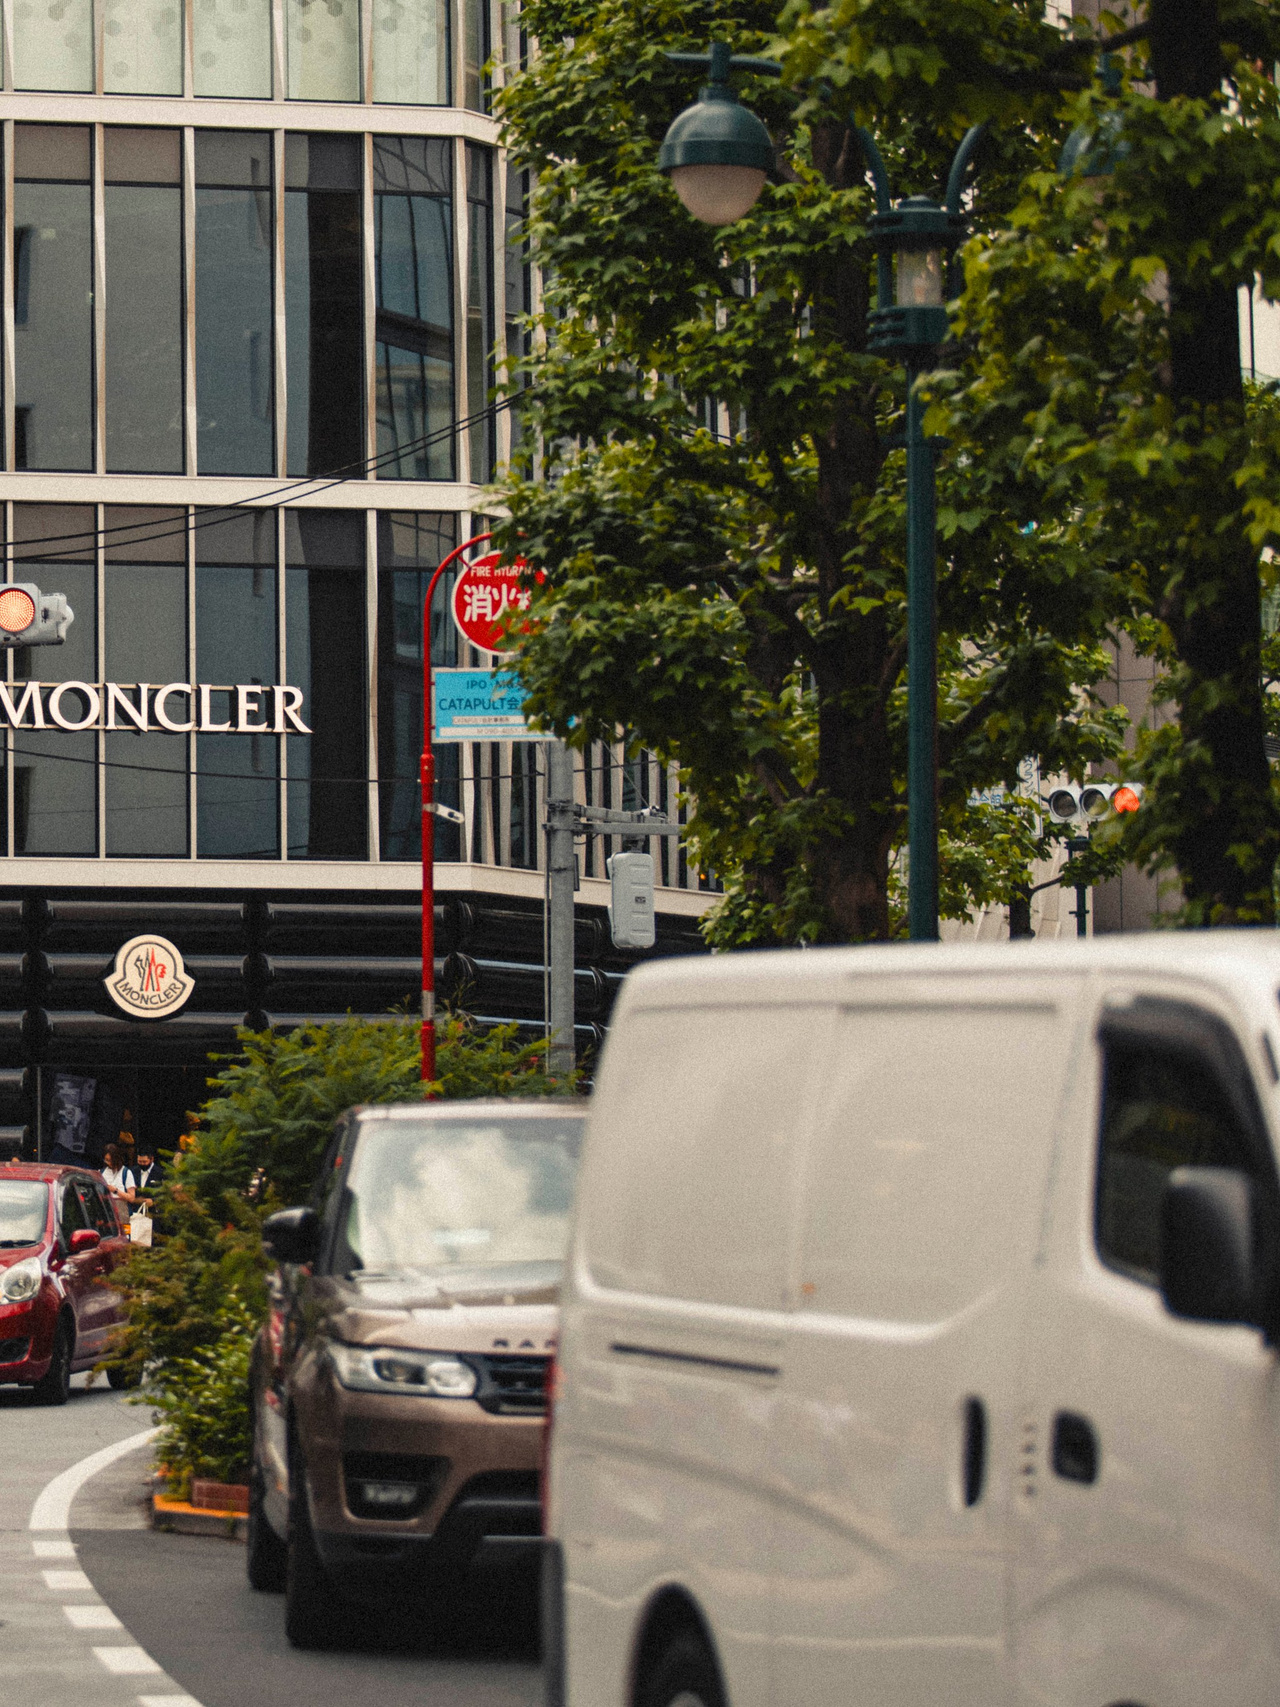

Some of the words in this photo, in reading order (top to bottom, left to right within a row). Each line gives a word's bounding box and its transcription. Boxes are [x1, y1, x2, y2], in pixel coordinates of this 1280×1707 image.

[470, 566, 491, 577] FIRE
[438, 697, 524, 711] CATAPULT会
[119, 982, 181, 1005] MONCLER
